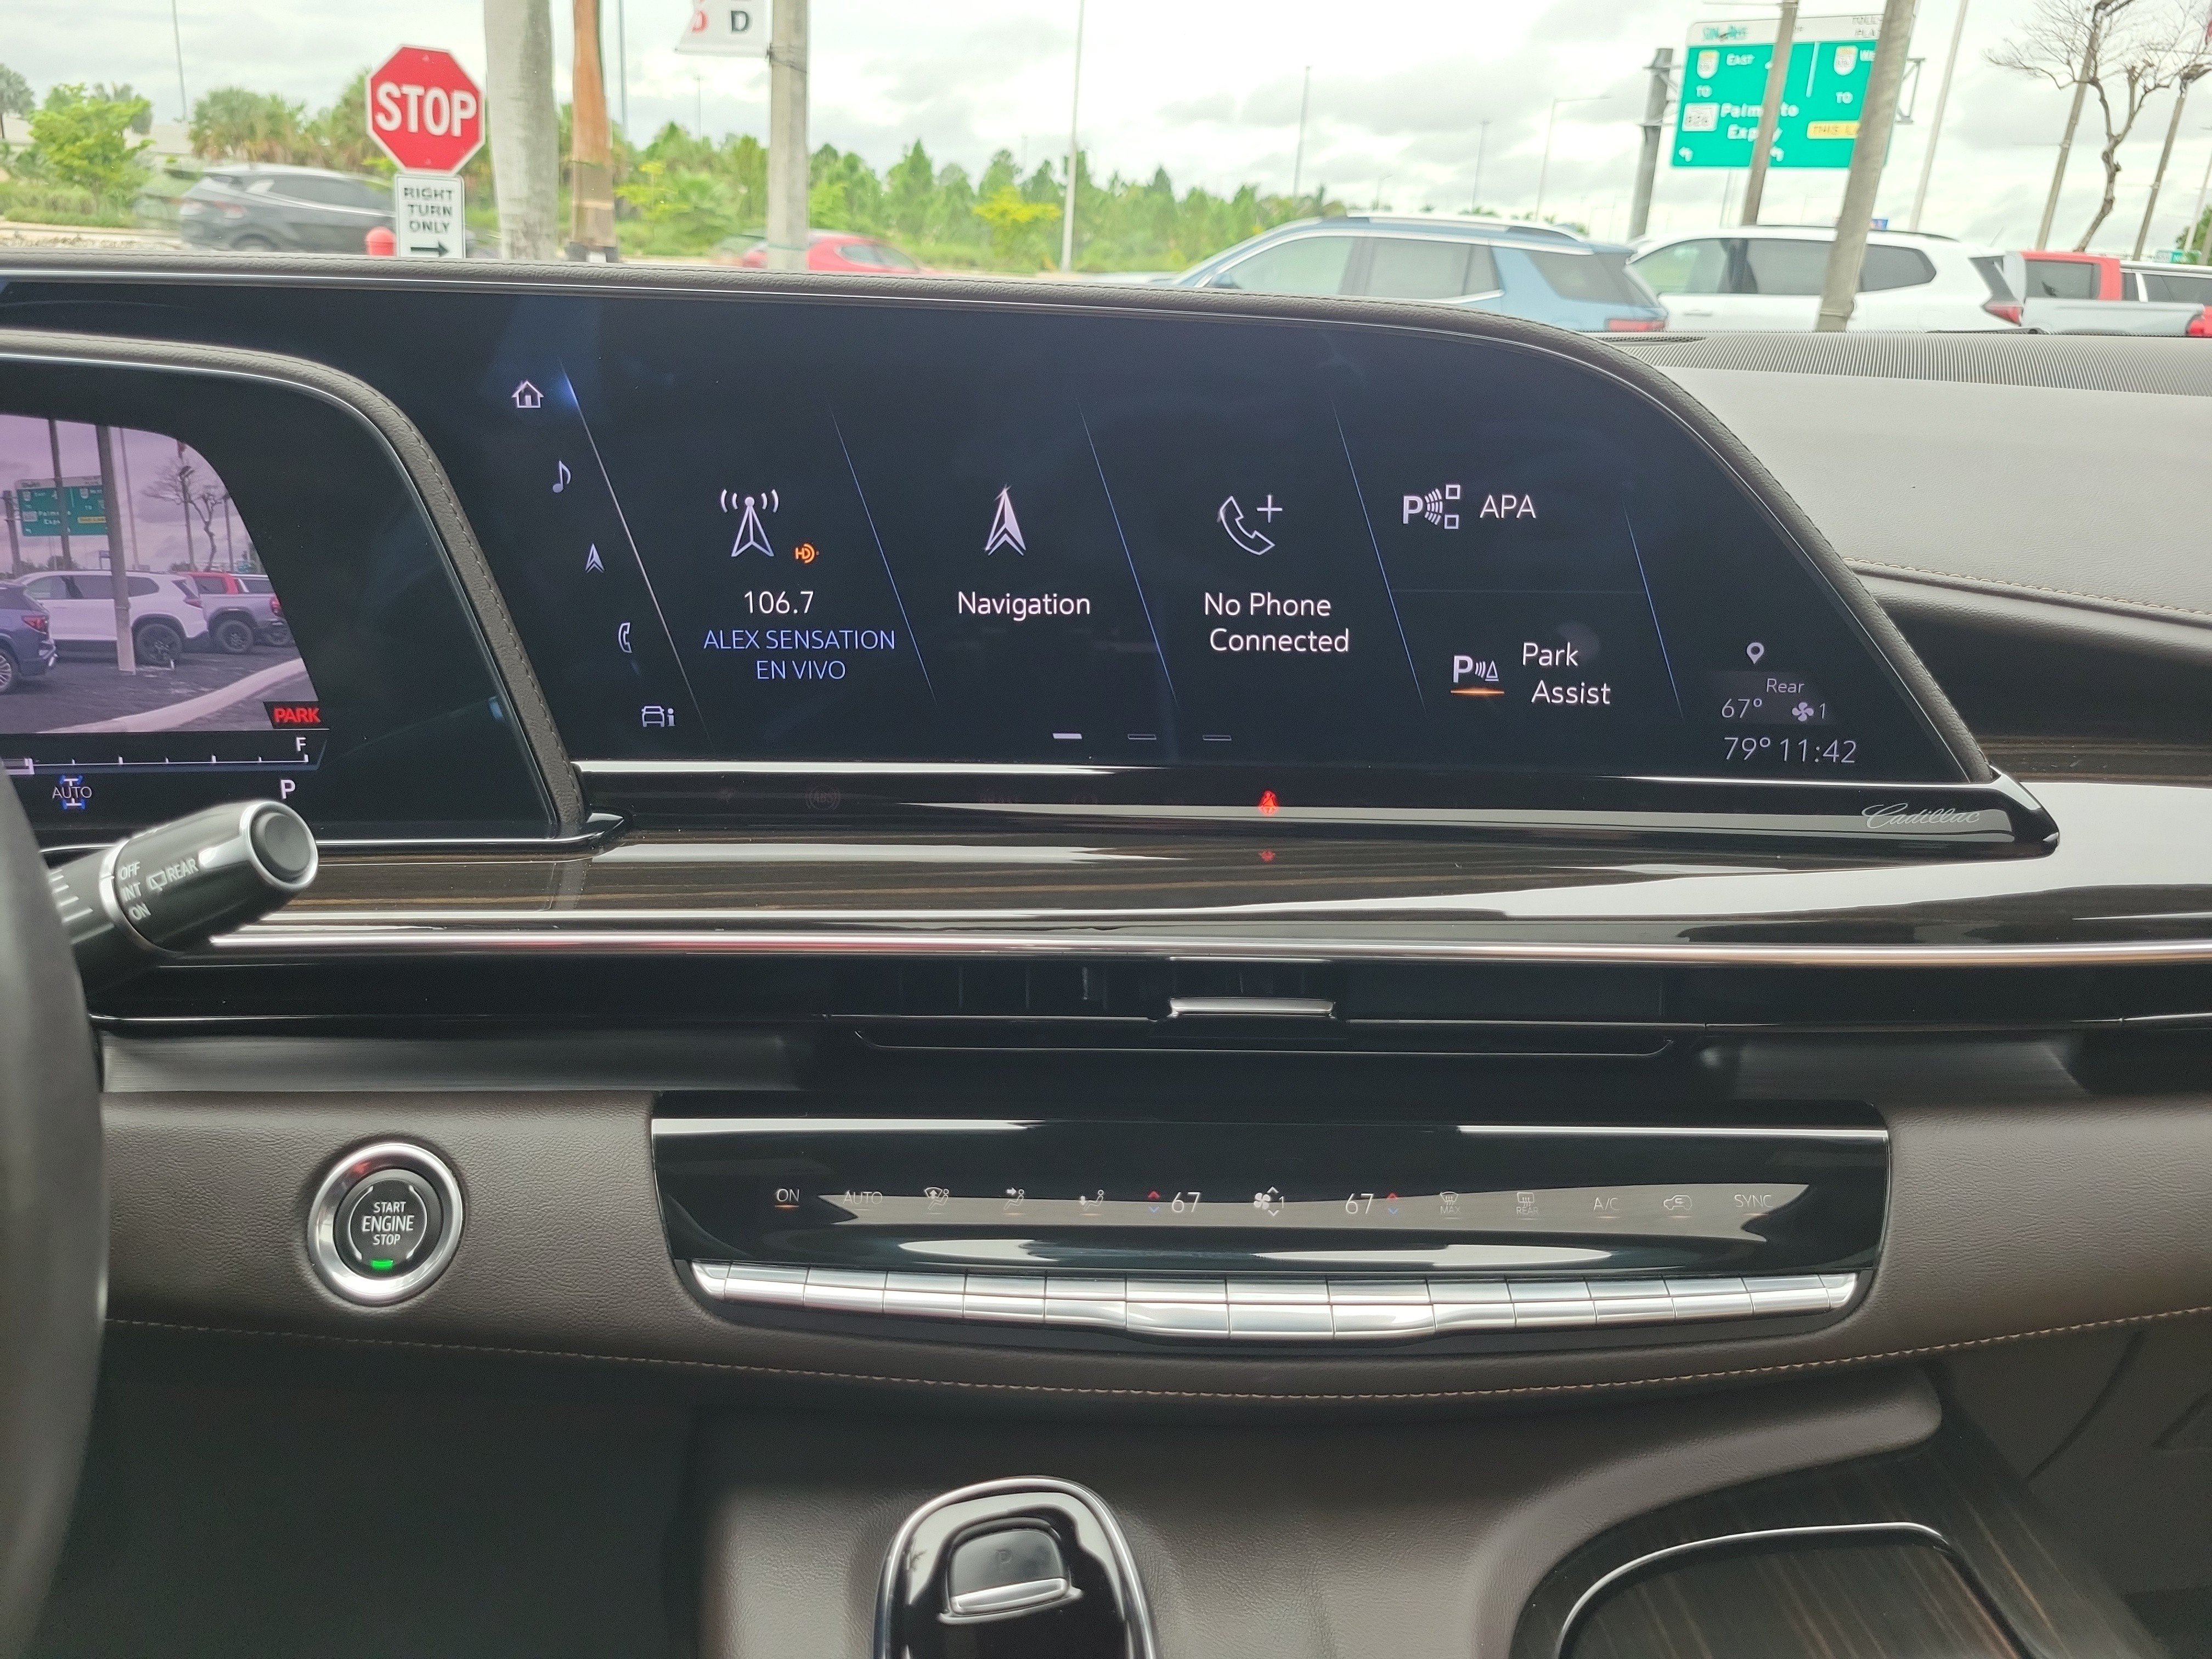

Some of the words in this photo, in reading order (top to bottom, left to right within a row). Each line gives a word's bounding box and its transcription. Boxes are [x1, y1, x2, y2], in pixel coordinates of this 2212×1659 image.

[731, 10, 751, 32] D
[375, 81, 477, 137] STOP
[404, 187, 453, 200] RIGHT
[408, 204, 452, 216] TURN
[409, 221, 449, 233] ONLY
[1480, 494, 1537, 518] APA
[744, 591, 814, 614] 106.7
[958, 591, 1090, 622] Navigation
[1205, 592, 1241, 616] No
[1250, 591, 1331, 617] Phone
[703, 630, 760, 649] ALEX
[766, 630, 895, 650] SENSATION
[1210, 628, 1349, 652] Connected
[1522, 641, 1578, 667] Park
[757, 660, 786, 679] EN
[792, 660, 845, 680] VIVO
[1531, 680, 1611, 704] Assist
[1766, 678, 1805, 693] Rear
[274, 707, 321, 724] PARK
[1722, 698, 1763, 719] 67°
[1819, 703, 1826, 719] 1
[296, 737, 306, 752] F
[1724, 737, 1771, 760] 79°
[1780, 738, 1857, 763] 11:42
[52, 786, 92, 799] AUTO
[280, 779, 296, 799] P
[1862, 803, 1980, 830] Cadillac
[117, 861, 140, 881] OFF
[166, 859, 199, 883] REAR
[122, 882, 142, 901] INT
[129, 904, 151, 921] ON
[776, 1188, 800, 1202] ON
[843, 1191, 883, 1205] AUTO
[1171, 1192, 1201, 1214] 67
[1279, 1196, 1285, 1209] 1
[1345, 1193, 1374, 1214] 67
[1593, 1197, 1618, 1211] A/C
[1734, 1194, 1774, 1208] SYNC
[374, 1201, 406, 1214] START
[1440, 1205, 1462, 1215] MAX
[1516, 1206, 1539, 1215] REAR
[362, 1215, 415, 1232] ENGINE
[373, 1233, 400, 1245] STOP
